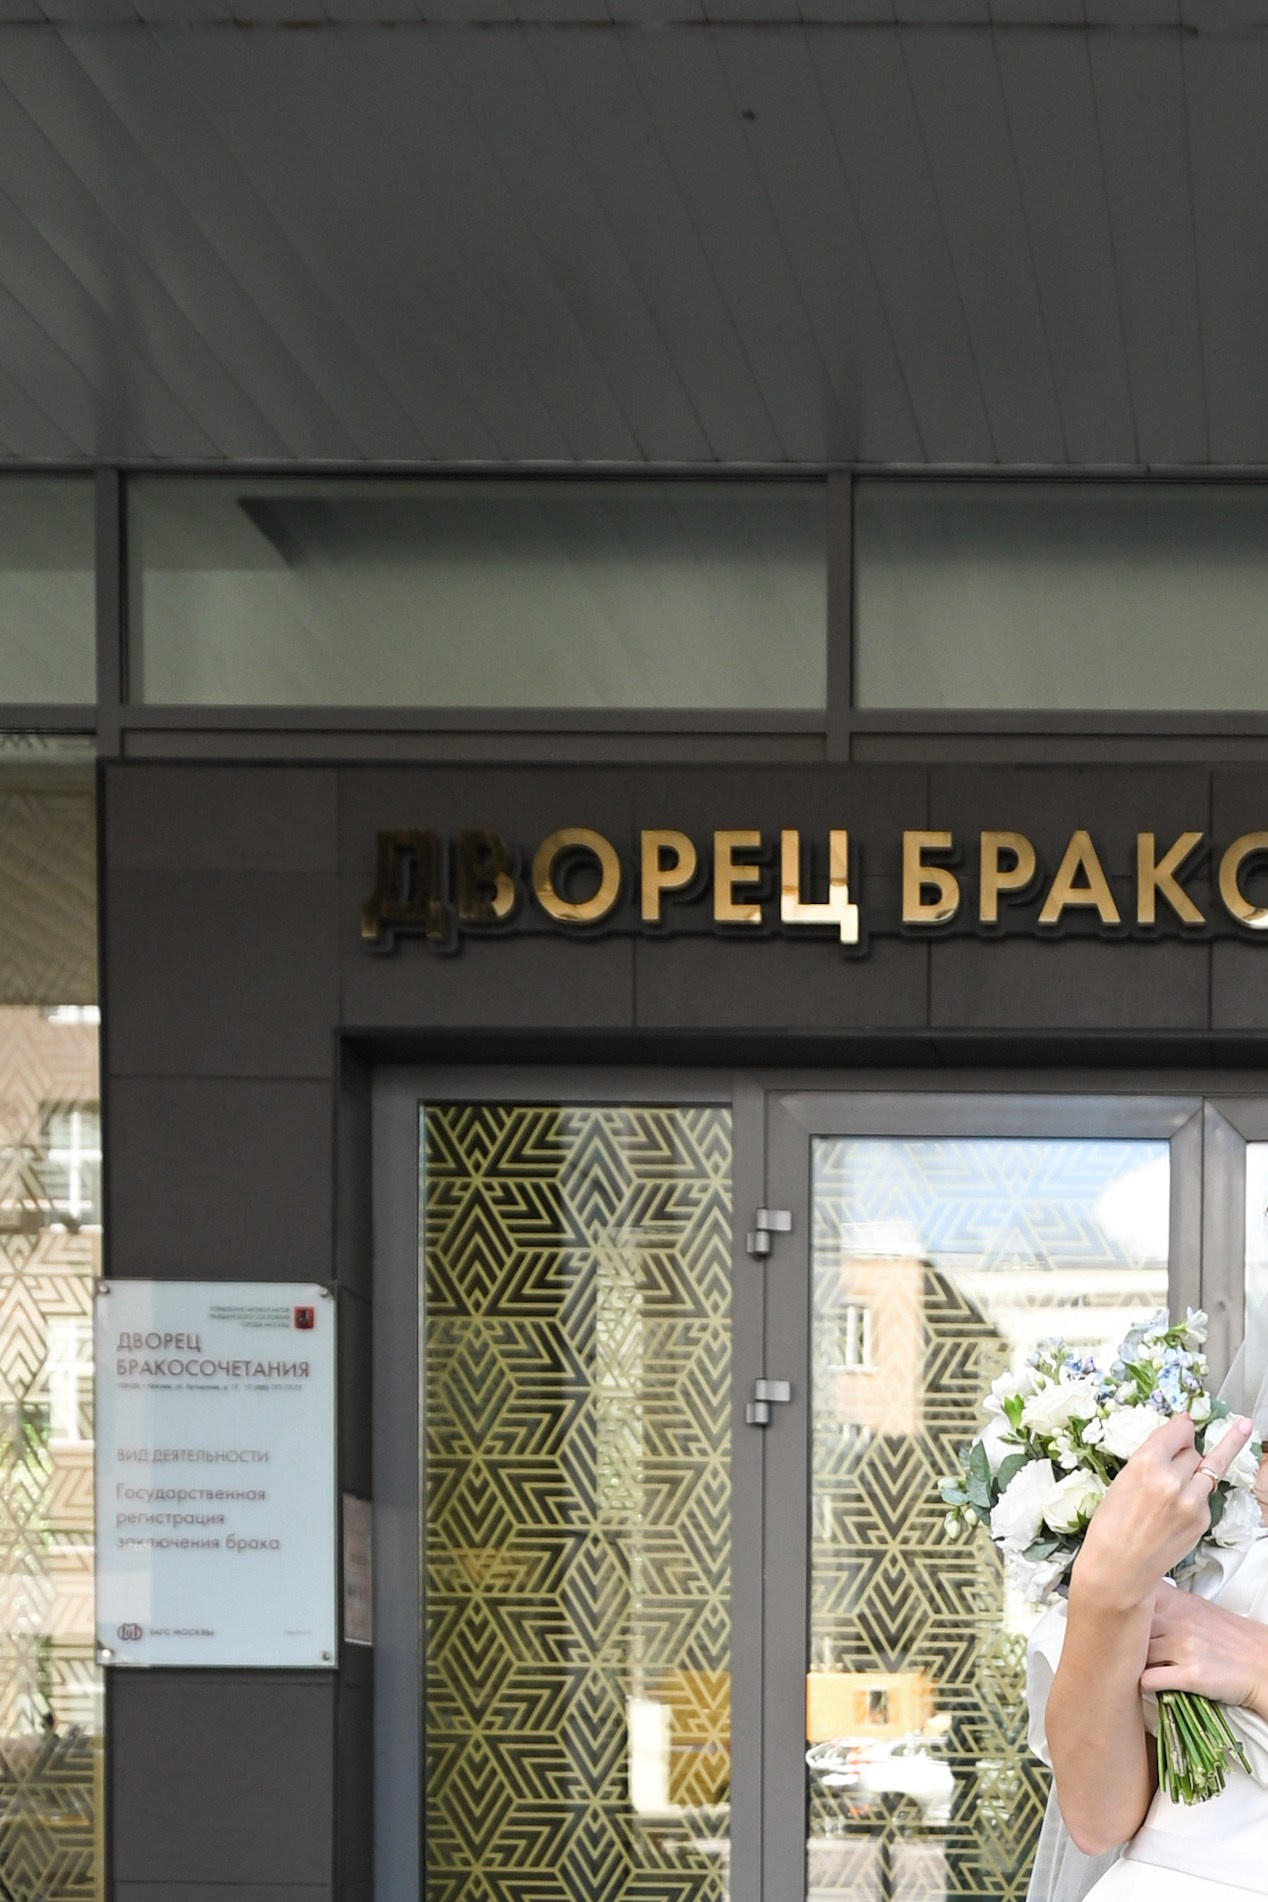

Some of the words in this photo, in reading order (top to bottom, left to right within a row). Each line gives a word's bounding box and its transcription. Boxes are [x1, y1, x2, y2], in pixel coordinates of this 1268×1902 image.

[361, 827, 859, 944] ДВОРЕЦ
[117, 1331, 202, 1352] ДВОРЕЦ
[116, 1358, 310, 1378] БРАКОСОЧЕТАНИЯ
[117, 1449, 148, 1464] ВИД
[151, 1449, 269, 1464] ДЕЯТЕЛЬНОСТИ
[116, 1482, 267, 1503] Государственная
[116, 1511, 225, 1527] регистрация
[116, 1535, 220, 1550] заключения
[225, 1533, 281, 1552] брака
